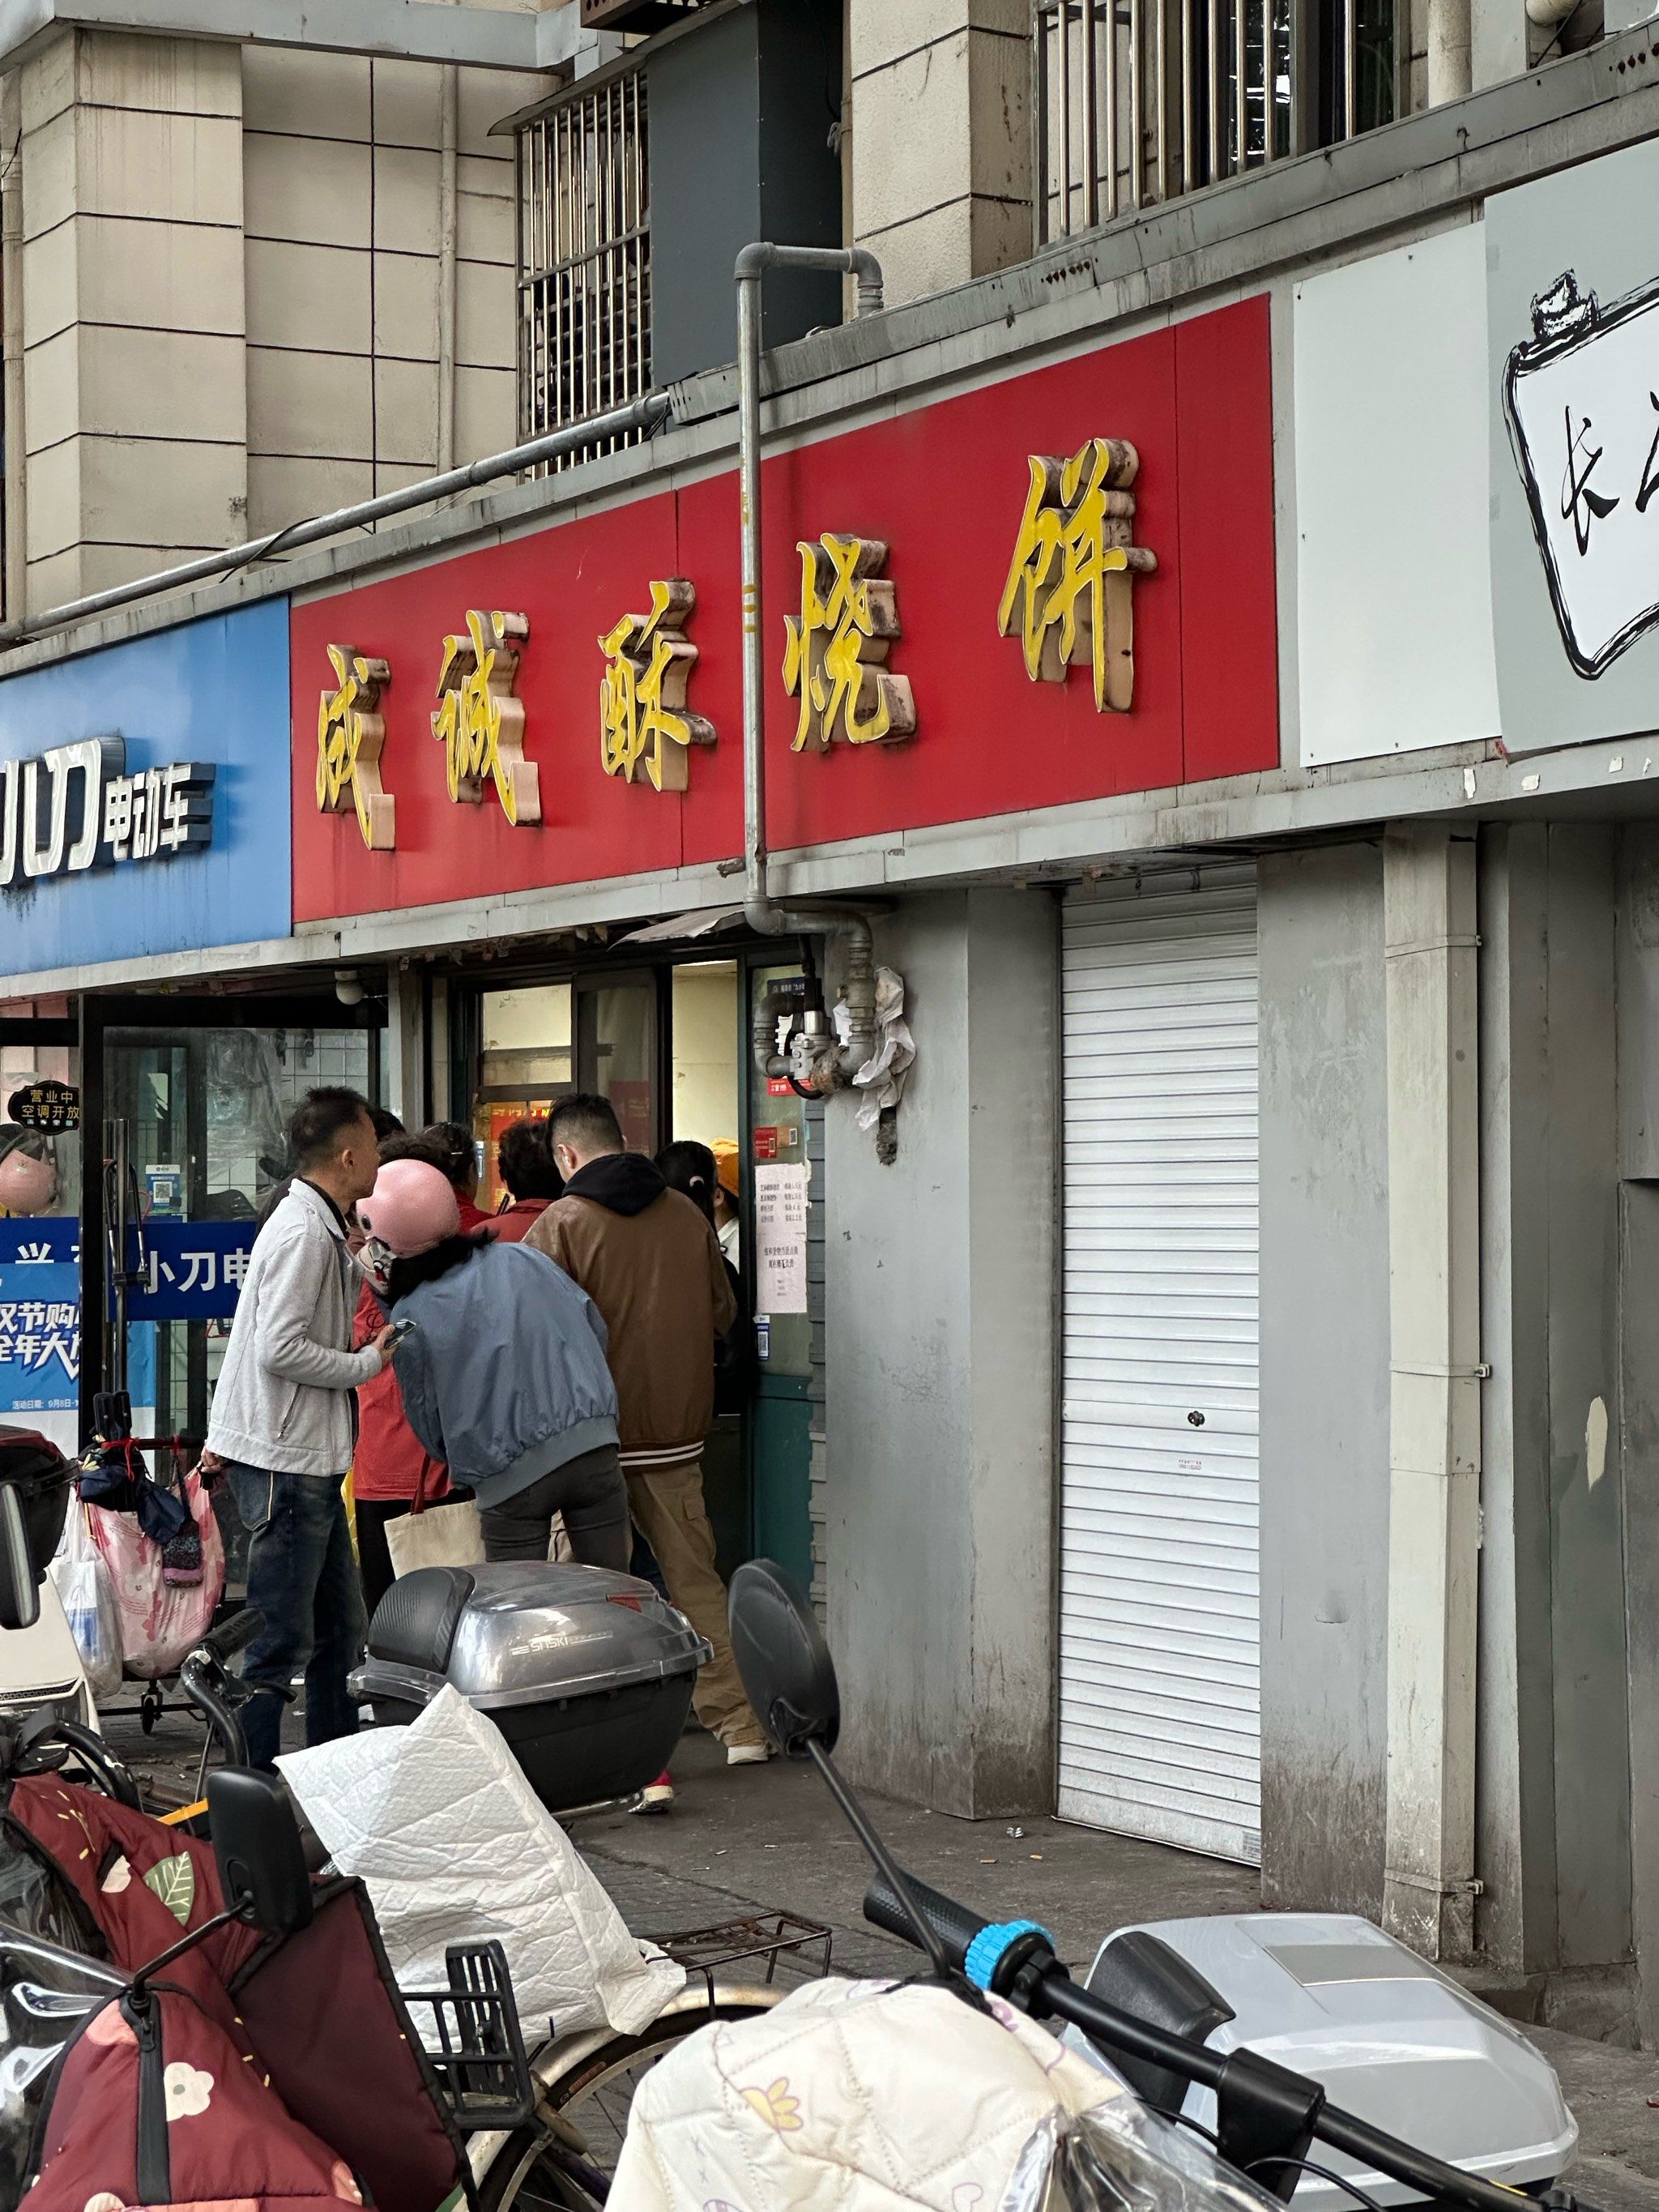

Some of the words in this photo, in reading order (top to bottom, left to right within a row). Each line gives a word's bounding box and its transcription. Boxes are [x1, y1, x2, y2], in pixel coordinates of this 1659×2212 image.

[30, 1089, 73, 1104] 营业中
[21, 1104, 79, 1119] 空调开放
